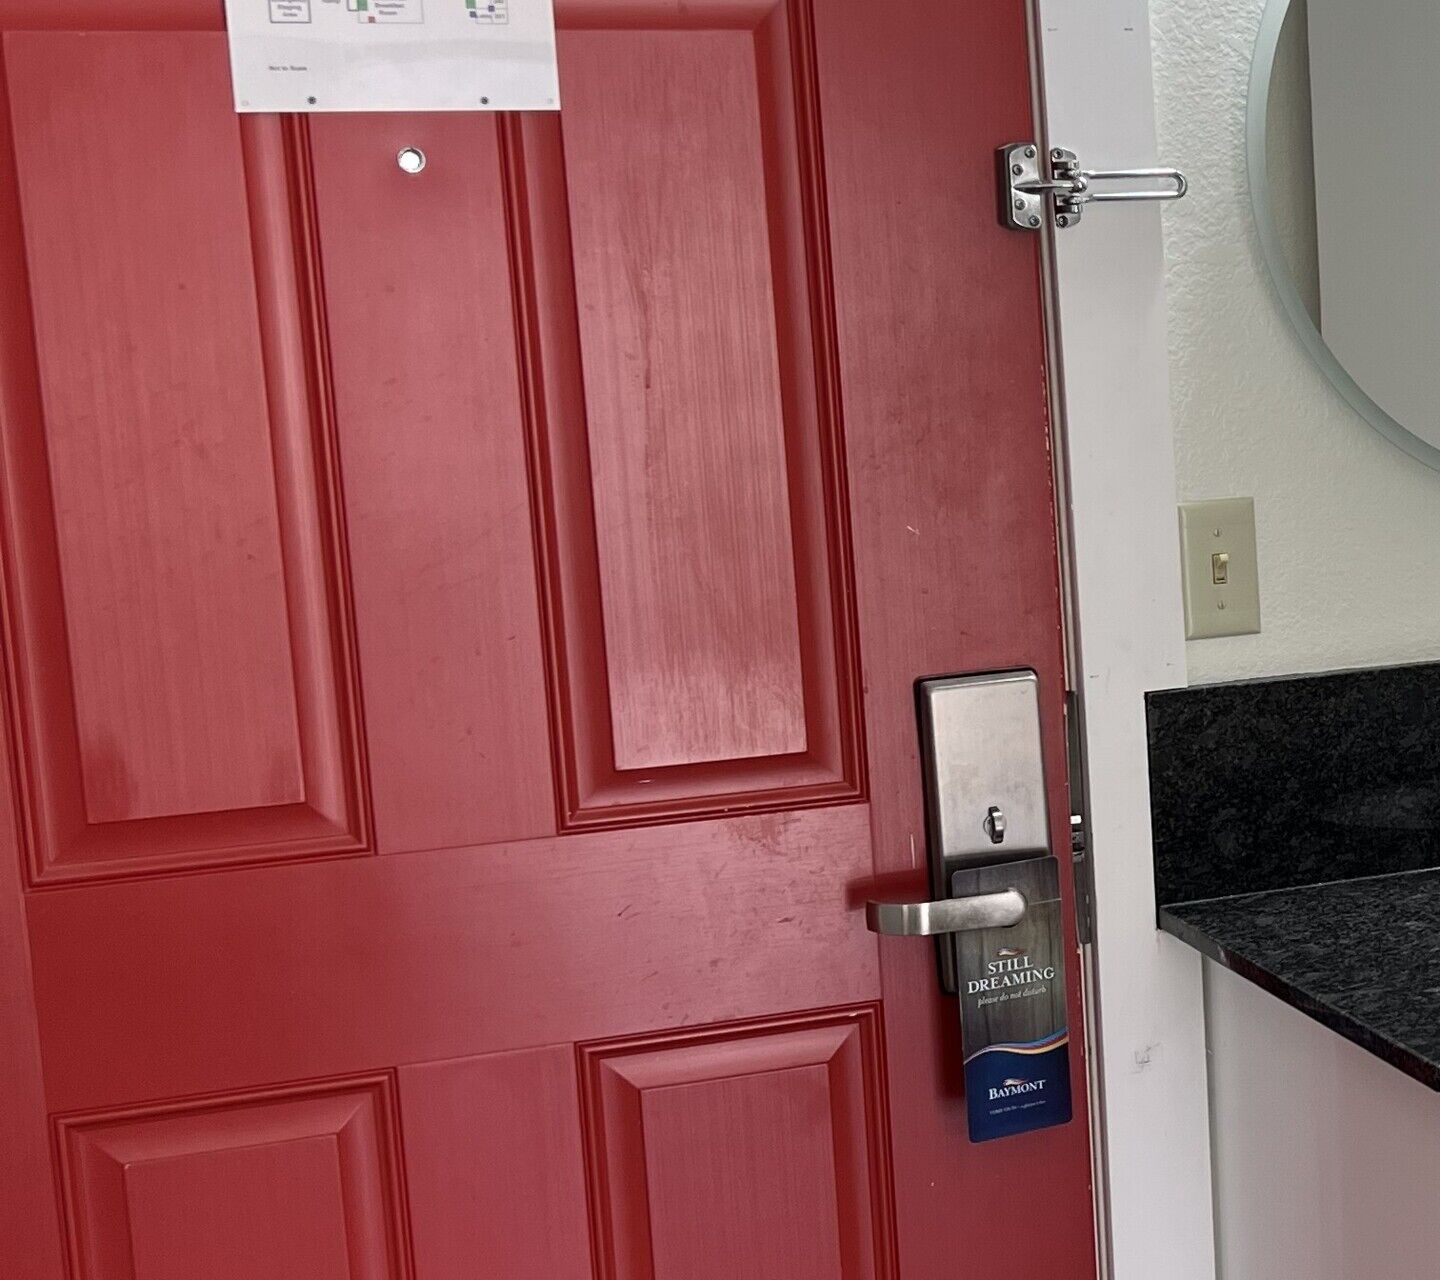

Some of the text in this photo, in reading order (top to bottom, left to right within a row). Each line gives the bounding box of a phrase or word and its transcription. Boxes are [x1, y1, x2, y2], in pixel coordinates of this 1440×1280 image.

[988, 955, 1034, 975] STILL
[967, 966, 1055, 994] DREAMING
[977, 985, 1047, 1008] please do not disturb
[988, 1079, 1047, 1100] BAYMONT
